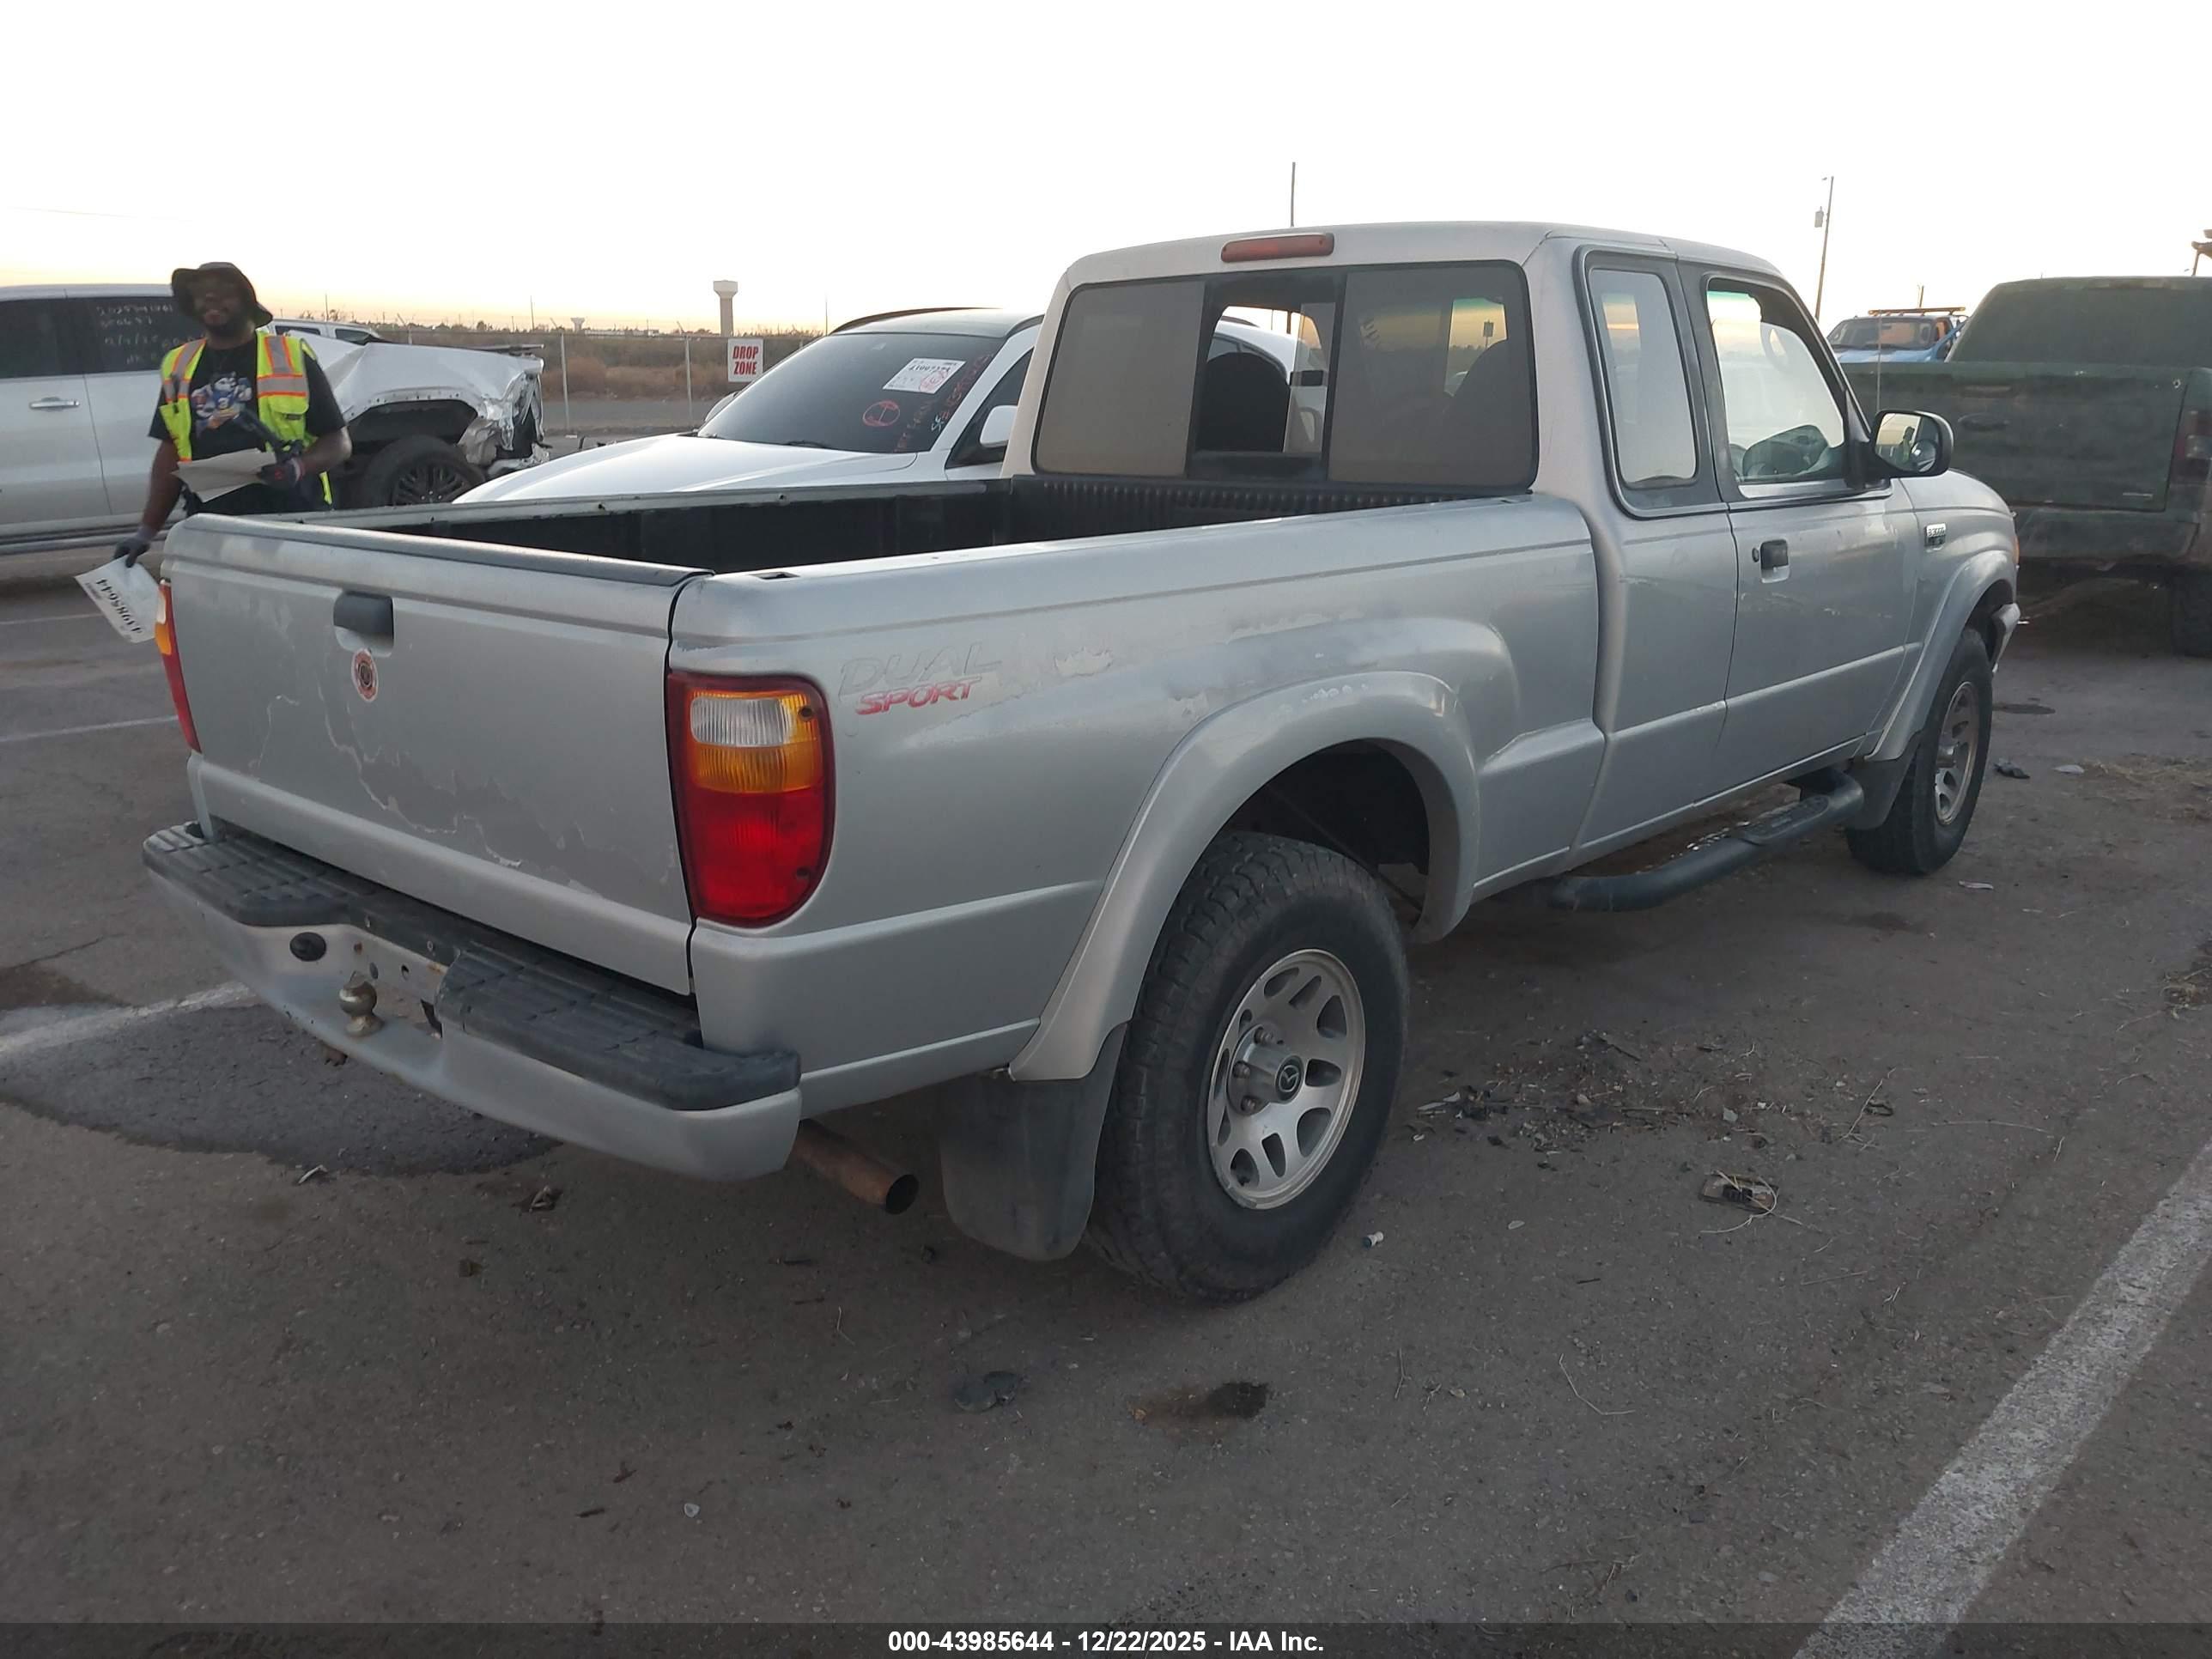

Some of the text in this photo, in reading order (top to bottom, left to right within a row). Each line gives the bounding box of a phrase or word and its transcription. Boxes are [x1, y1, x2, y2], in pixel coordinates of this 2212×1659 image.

[732, 345, 759, 360] DROP
[733, 361, 757, 375] ZONE
[838, 641, 1002, 699] DUAL
[856, 675, 982, 715] SPORT
